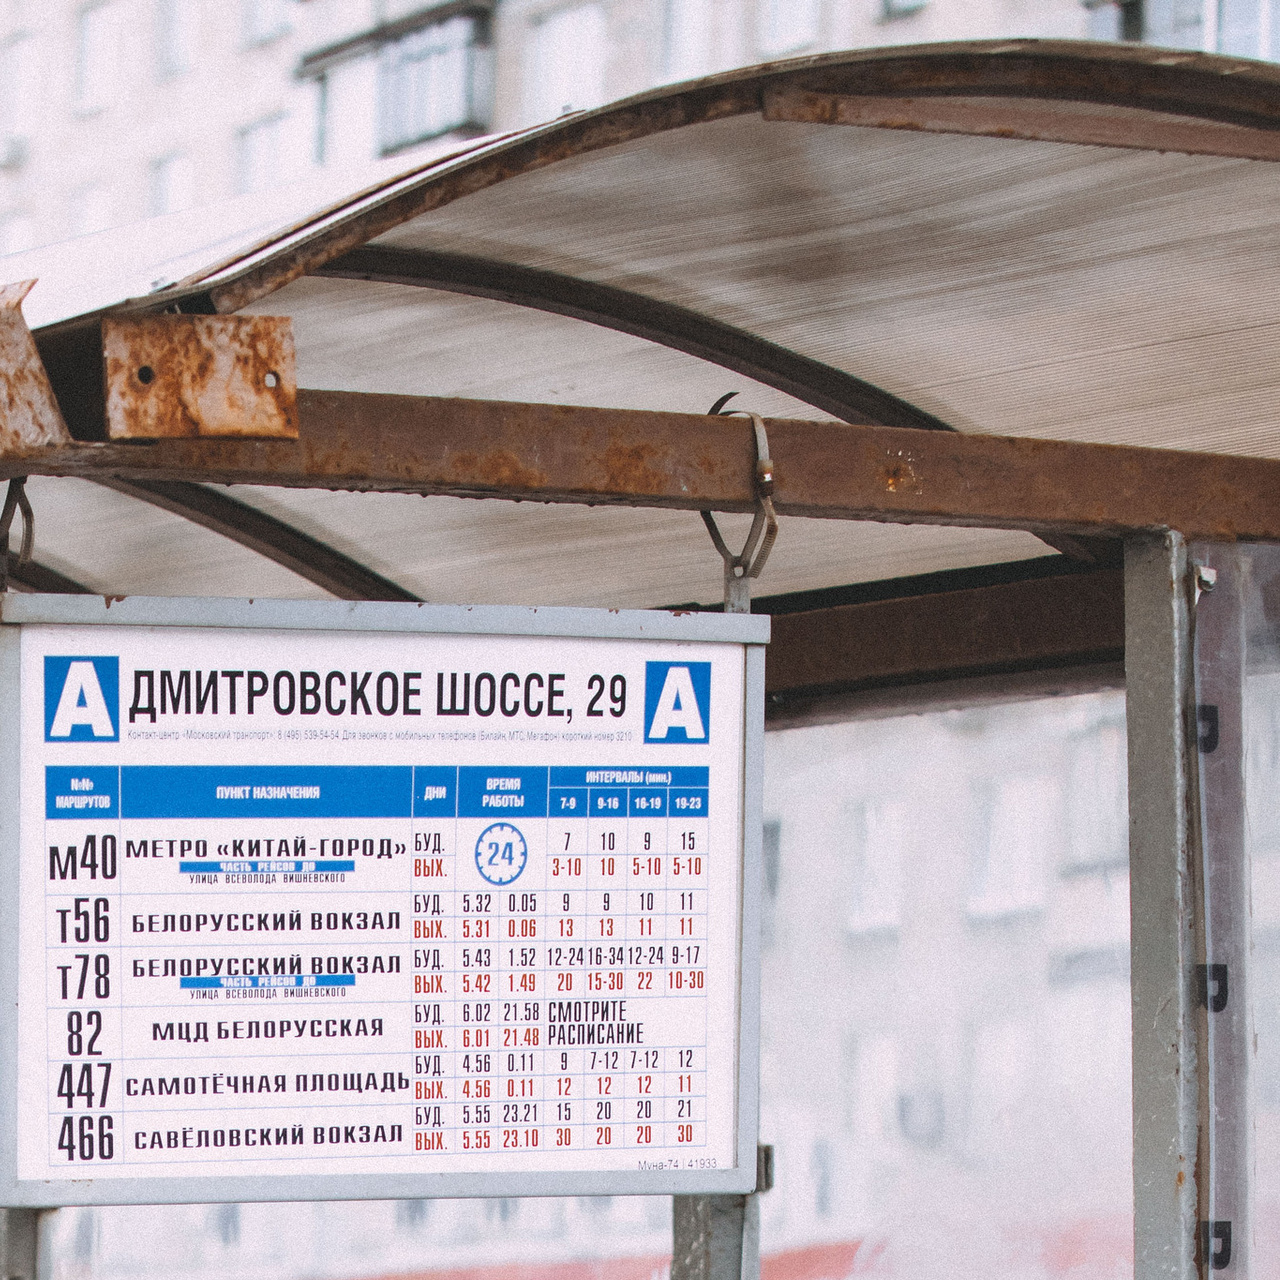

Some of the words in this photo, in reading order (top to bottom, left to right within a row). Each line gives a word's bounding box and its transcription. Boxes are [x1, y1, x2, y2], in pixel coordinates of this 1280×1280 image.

[51, 662, 114, 736] А
[129, 670, 421, 723] ДМИТРОВСКОЕ
[437, 672, 572, 724] ШОССЕ,
[587, 674, 626, 718] 29
[649, 667, 705, 738] А
[128, 730, 179, 740] Контакт-центр
[182, 730, 230, 740] «Московский
[278, 730, 281, 740] 8
[285, 730, 301, 740] (495)
[305, 730, 339, 740] 539-54-54
[342, 730, 356, 741] Для
[395, 730, 435, 741] мобильных
[438, 732, 475, 742] телефонов
[562, 731, 591, 742] короткий
[594, 732, 614, 743] номер
[616, 732, 632, 741] 3210
[487, 778, 520, 789] ВРЕМЯ
[587, 771, 643, 782] ИНТЕРВАЛЫ
[646, 772, 671, 783] (мин.)
[217, 787, 250, 798] ПУНКТ
[253, 787, 319, 798] НАЗНАЧЕНИЯ
[425, 787, 446, 799] ДНИ
[483, 795, 524, 806] РАБОТЫ
[56, 796, 110, 808] МАРШРУТОВ
[562, 798, 575, 808] 7-9
[598, 798, 618, 808] 9-16
[636, 798, 661, 808] 16-19
[676, 798, 701, 808] 19-23
[126, 840, 207, 858] МЕТРО
[217, 836, 406, 859] «КИТАЙ-ГОРОД»
[415, 833, 444, 853] БУД.
[565, 833, 570, 850] 7
[602, 833, 615, 850] 10
[644, 832, 650, 850] 9
[682, 832, 695, 850] 15
[488, 842, 514, 865] 24
[220, 862, 251, 872] ЧАСТЬ
[302, 862, 316, 872] ДО
[415, 859, 447, 877] ВЫХ.
[553, 858, 581, 876] 3-10
[601, 858, 614, 875] 10
[633, 858, 660, 875] 5-10
[674, 857, 701, 875] 5-10
[190, 874, 218, 885] УЛИЦА
[225, 873, 277, 884] ВСЕВОЛОДА
[283, 873, 345, 883] ВИШНЕВСКОГО
[414, 894, 444, 915] БУД.
[463, 894, 491, 912] 5.32
[509, 894, 536, 912] 0.05
[563, 893, 569, 911] 9
[603, 893, 609, 911] 9
[640, 893, 653, 910] 10
[681, 893, 692, 910] 11
[56, 898, 109, 943] т56
[133, 910, 301, 932] БЕЛОРУССКИЙ
[311, 912, 400, 930] ВОКЗАЛ
[414, 920, 447, 938] ВЫХ.
[463, 920, 489, 938] 5.31
[509, 919, 536, 937] 0.06
[560, 919, 573, 936] 13
[600, 919, 613, 936] 13
[640, 919, 651, 935] 11
[680, 918, 692, 935] 11
[415, 949, 444, 970] БУД.
[463, 949, 490, 967] 5.43
[509, 948, 535, 966] 1.52
[548, 948, 583, 966] 12-24
[589, 947, 623, 965] 16-34
[629, 946, 663, 964] 12-24
[672, 946, 699, 964] 9-17
[132, 954, 302, 977] БЕЛОРУССКИЙ
[310, 956, 401, 974] ВОКЗАЛ
[57, 954, 110, 999] т78
[220, 978, 252, 987] ЧАСТЬ
[302, 977, 316, 987] ДО
[415, 975, 447, 993] ВЫХ.
[463, 974, 490, 992] 5.42
[509, 974, 535, 991] 1.49
[558, 973, 572, 991] 20
[588, 972, 623, 990] 15-30
[638, 972, 652, 989] 22
[669, 971, 703, 989] 10-30
[190, 989, 218, 1000] УЛИЦА
[226, 988, 277, 999] ВСЕВОЛОДА
[284, 988, 346, 998] ВИШНЕВСКОГО
[415, 1004, 444, 1025] БУД.
[463, 1003, 490, 1022] 6.02
[504, 1003, 539, 1021] 21.58
[549, 1001, 626, 1022] СМОТРИТЕ
[67, 1011, 102, 1056] 82
[153, 1022, 208, 1043] МЦД
[218, 1019, 383, 1039] БЕЛОРУССКАЯ
[415, 1030, 448, 1048] ВЫХ.
[463, 1029, 489, 1047] 6.01
[504, 1028, 539, 1046] 21.48
[549, 1023, 643, 1045] РАСПИСАНИЕ
[416, 1055, 445, 1076] БУД.
[463, 1054, 490, 1072] 4.56
[508, 1054, 533, 1072] 0.11
[561, 1052, 567, 1070] 9
[591, 1051, 618, 1069] 7-12
[631, 1051, 658, 1068] 7-12
[679, 1050, 692, 1067] 12
[57, 1063, 111, 1108] 447
[126, 1073, 286, 1096] САМОТЁЧНАЯ
[296, 1072, 409, 1093] ПЛОЩАДЬ
[416, 1081, 448, 1099] ВЫХ.
[463, 1080, 490, 1098] 4.56
[508, 1079, 533, 1097] 0.11
[558, 1078, 571, 1095] 12
[598, 1077, 611, 1094] 12
[638, 1076, 651, 1093] 12
[679, 1075, 690, 1092] 11
[416, 1106, 445, 1127] БУД.
[463, 1105, 490, 1123] 5.55
[504, 1104, 536, 1122] 23.21
[558, 1103, 570, 1120] 15
[597, 1102, 611, 1119] 20
[637, 1101, 651, 1118] 20
[678, 1100, 690, 1117] 21
[58, 1115, 113, 1161] 466
[135, 1125, 303, 1149] САВЁЛОВСКИЙ
[314, 1125, 402, 1144] ВОКЗАЛ
[416, 1132, 448, 1150] ВЫХ.
[463, 1131, 490, 1149] 5.55
[503, 1129, 538, 1148] 23.10
[557, 1128, 570, 1146] 30
[597, 1127, 611, 1145] 20
[637, 1126, 651, 1143] 20
[678, 1125, 692, 1142] 30
[688, 1158, 717, 1168] 41933
